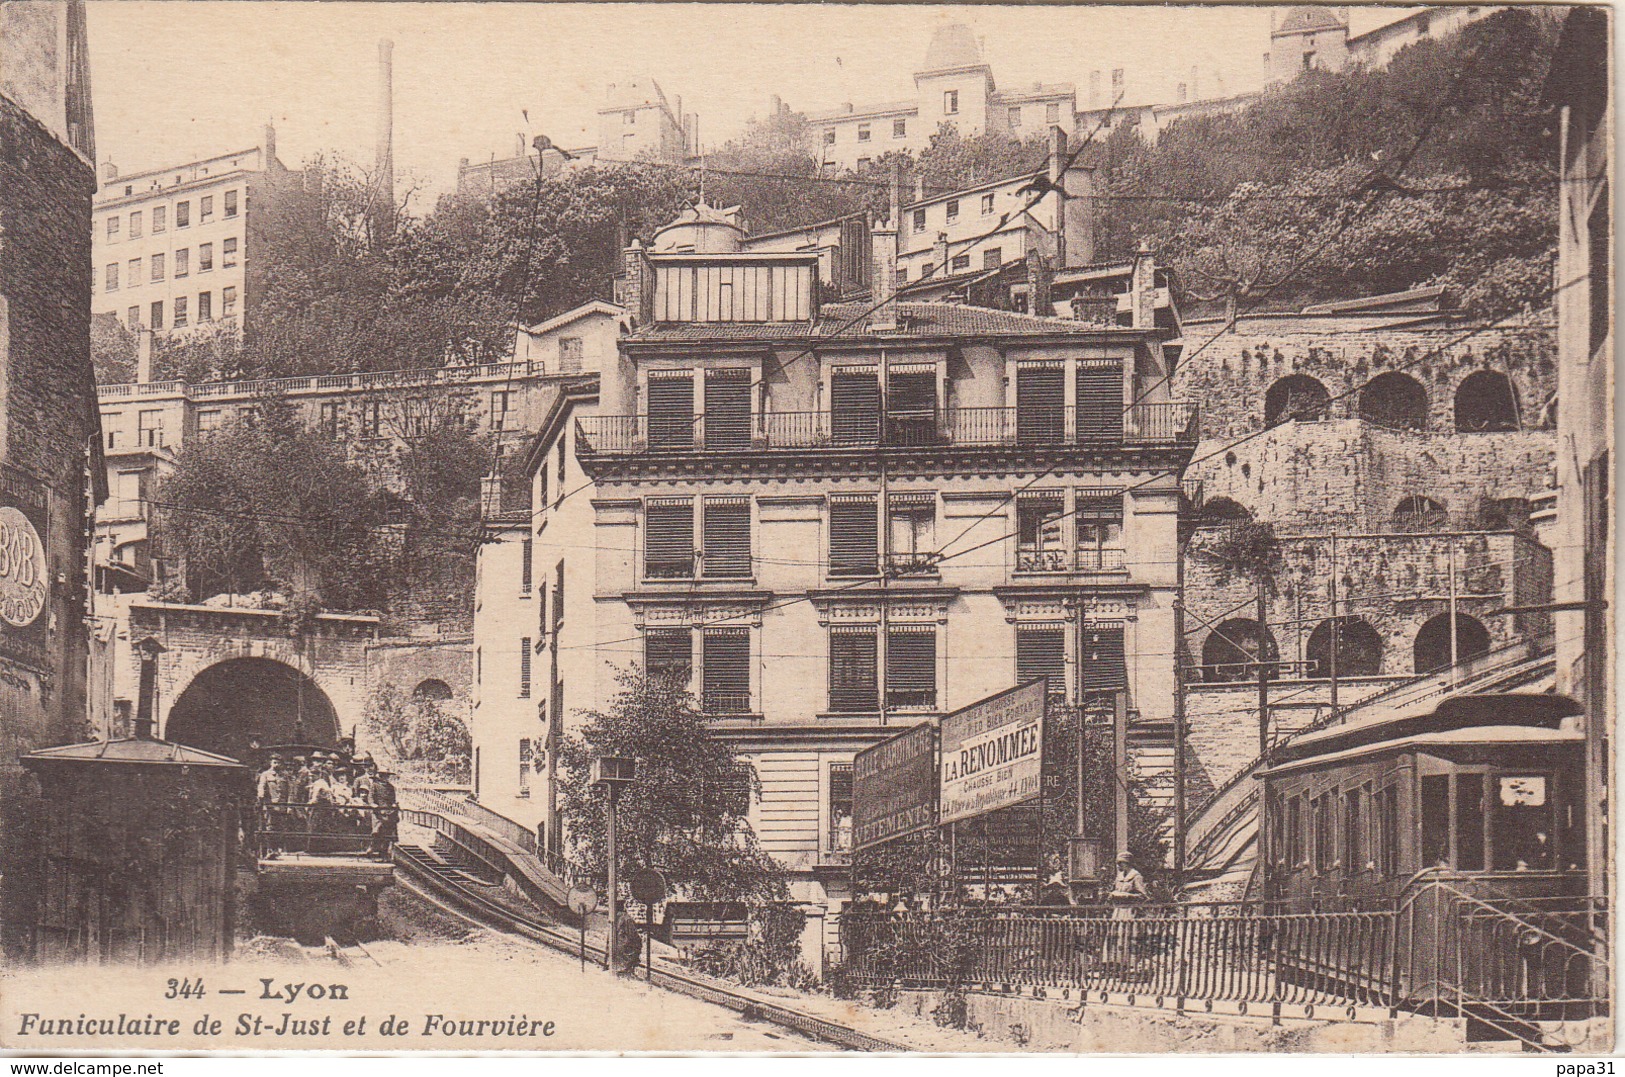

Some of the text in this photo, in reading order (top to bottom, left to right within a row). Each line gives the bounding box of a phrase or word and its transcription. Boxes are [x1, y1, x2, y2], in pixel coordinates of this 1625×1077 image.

[0, 580, 45, 622] MOUTH
[987, 712, 1003, 728] BIEN
[944, 761, 958, 783] LA
[960, 723, 1039, 777] RENOMMEE
[964, 768, 1013, 793] CHAUSSE BIEN
[854, 802, 930, 843] VETEMENTS
